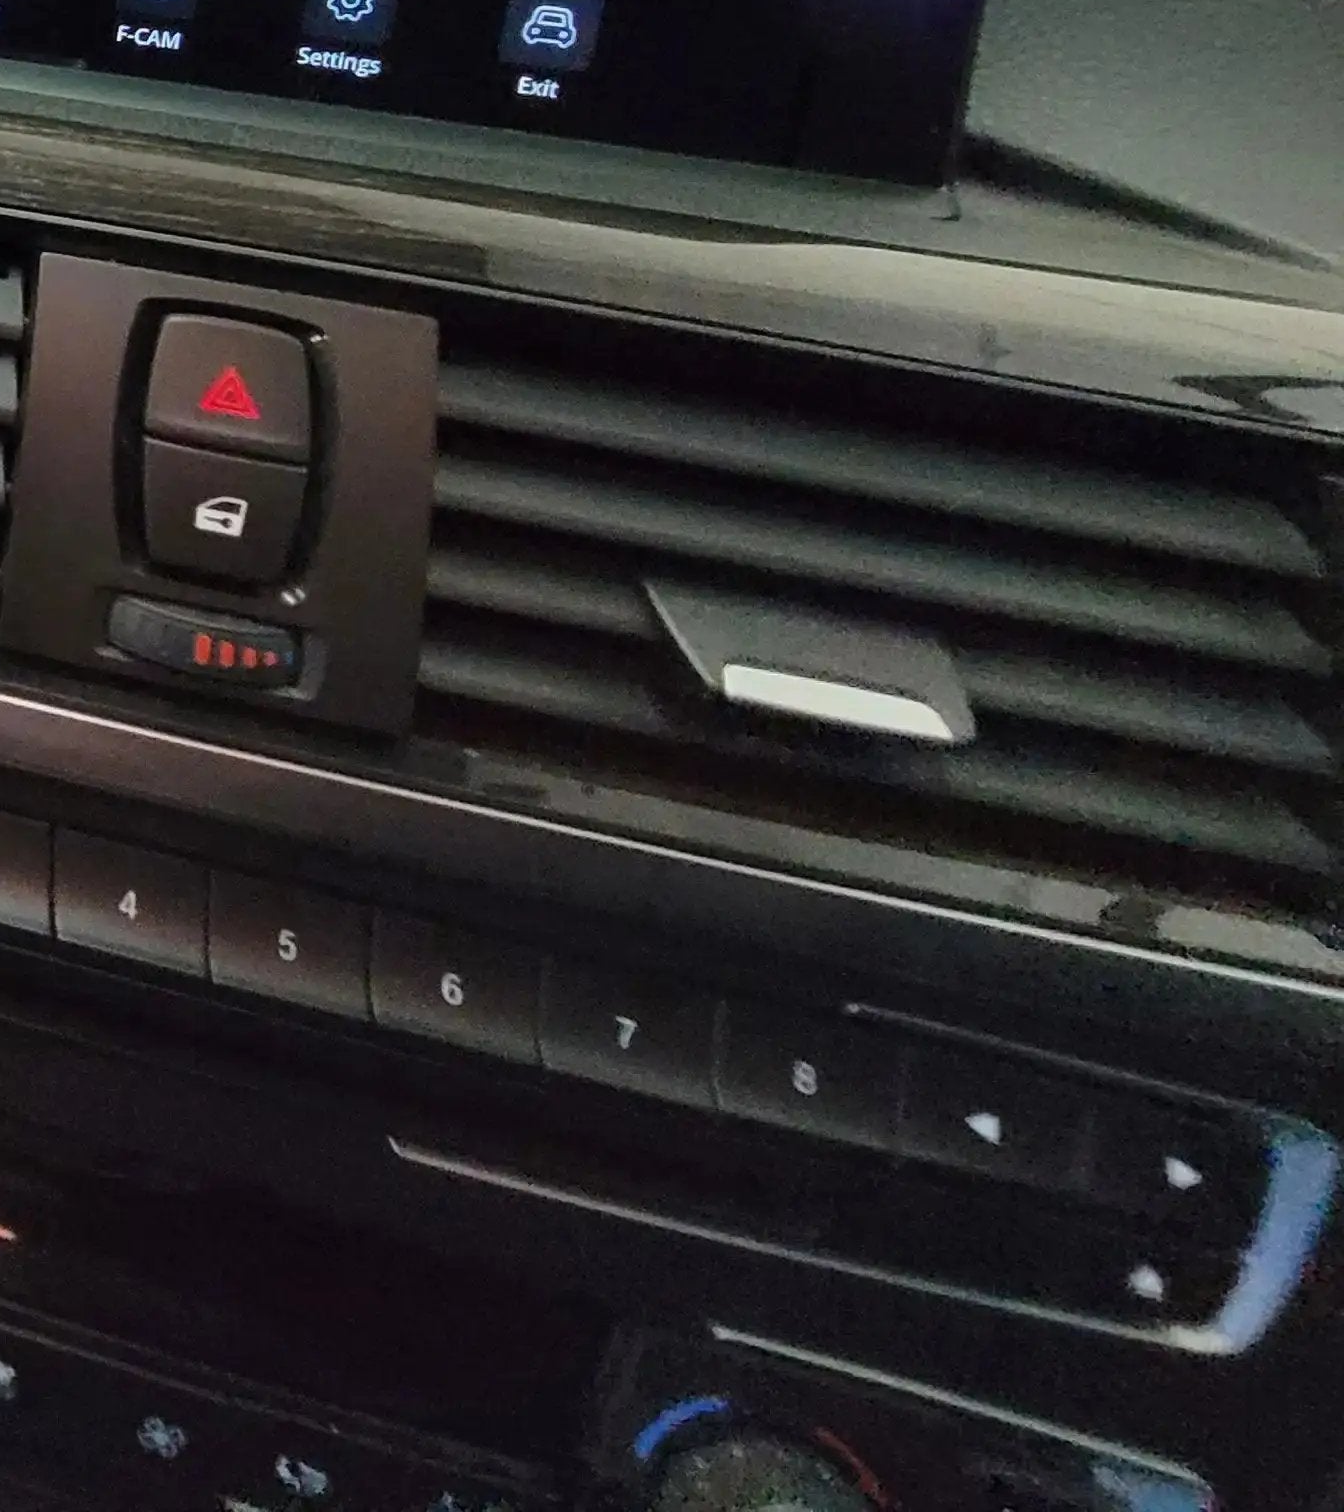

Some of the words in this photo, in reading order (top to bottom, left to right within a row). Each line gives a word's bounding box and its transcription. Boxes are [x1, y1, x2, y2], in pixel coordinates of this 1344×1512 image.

[115, 24, 182, 52] F-CAM
[296, 45, 382, 79] Settings
[515, 73, 560, 102] Exit
[117, 889, 139, 920] 4
[277, 930, 298, 963] 5
[440, 973, 464, 1007] 6
[614, 1014, 639, 1050] 7
[791, 1059, 818, 1097] 8
